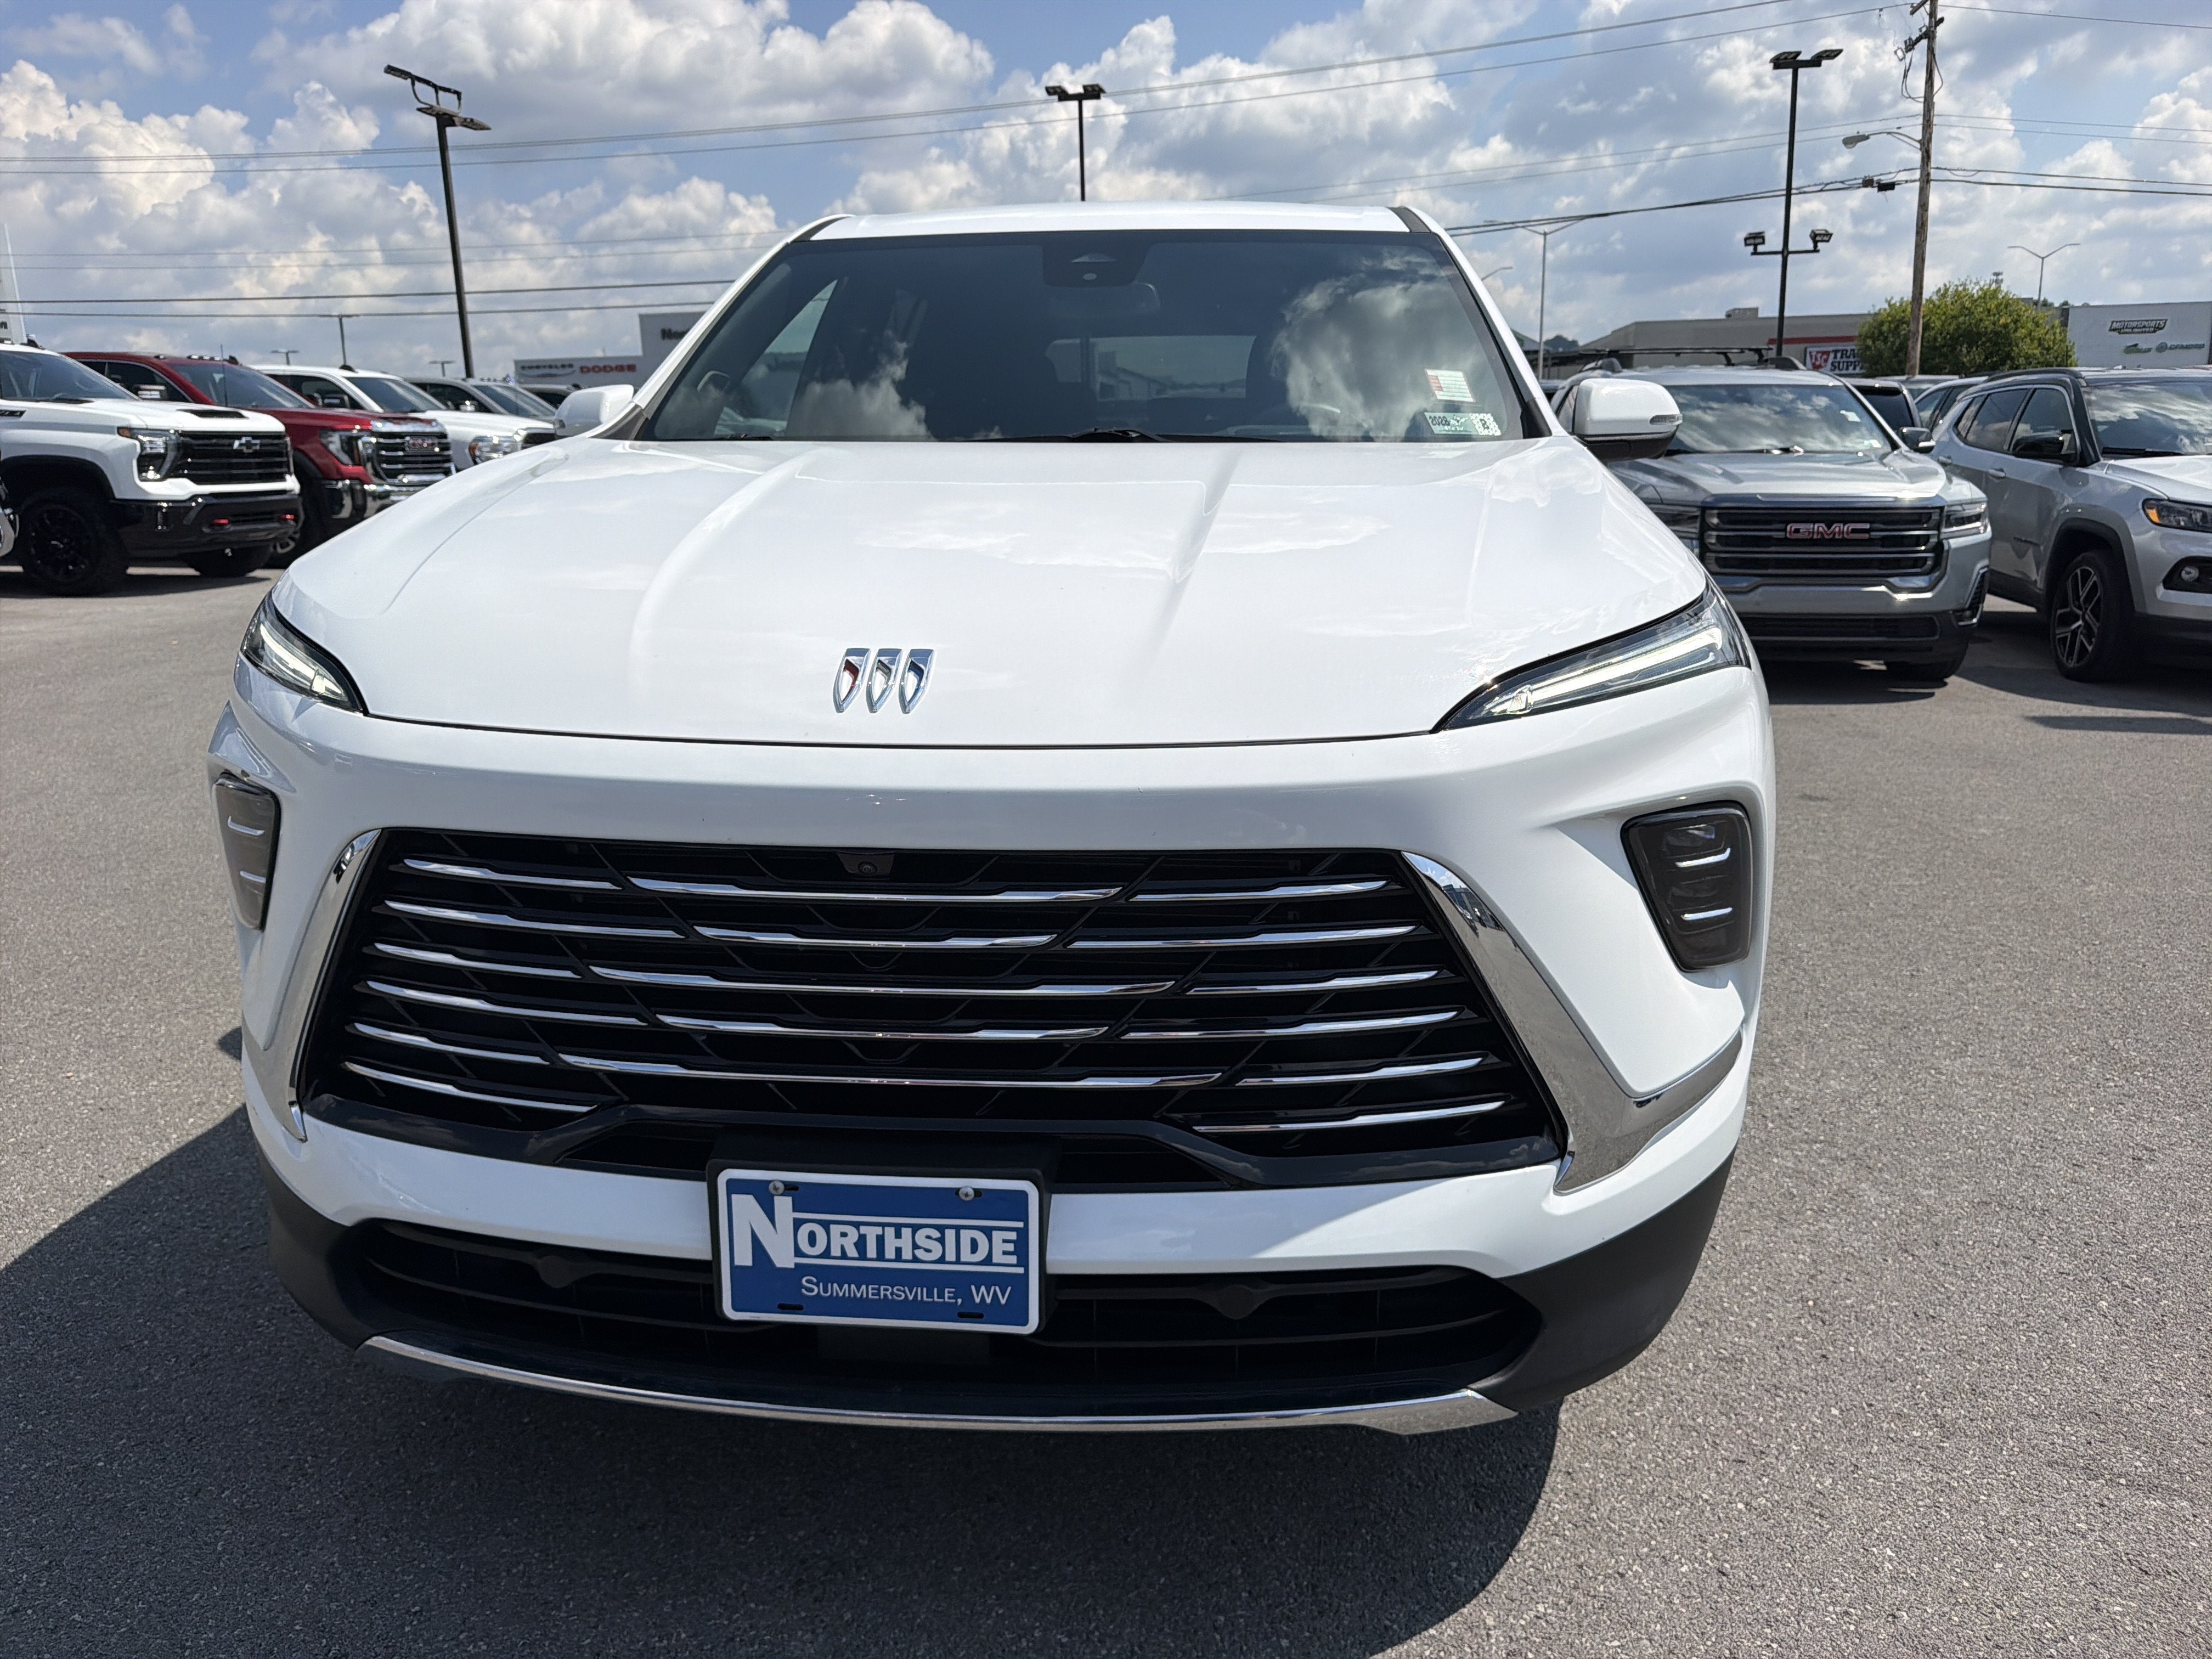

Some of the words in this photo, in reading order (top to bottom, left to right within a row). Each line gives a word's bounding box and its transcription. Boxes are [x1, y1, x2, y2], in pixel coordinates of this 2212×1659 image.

[2113, 320, 2165, 329] MOTORSPORTS
[579, 364, 636, 374] DODGE
[1786, 523, 1870, 539] GMC
[971, 1285, 1012, 1305] WV
